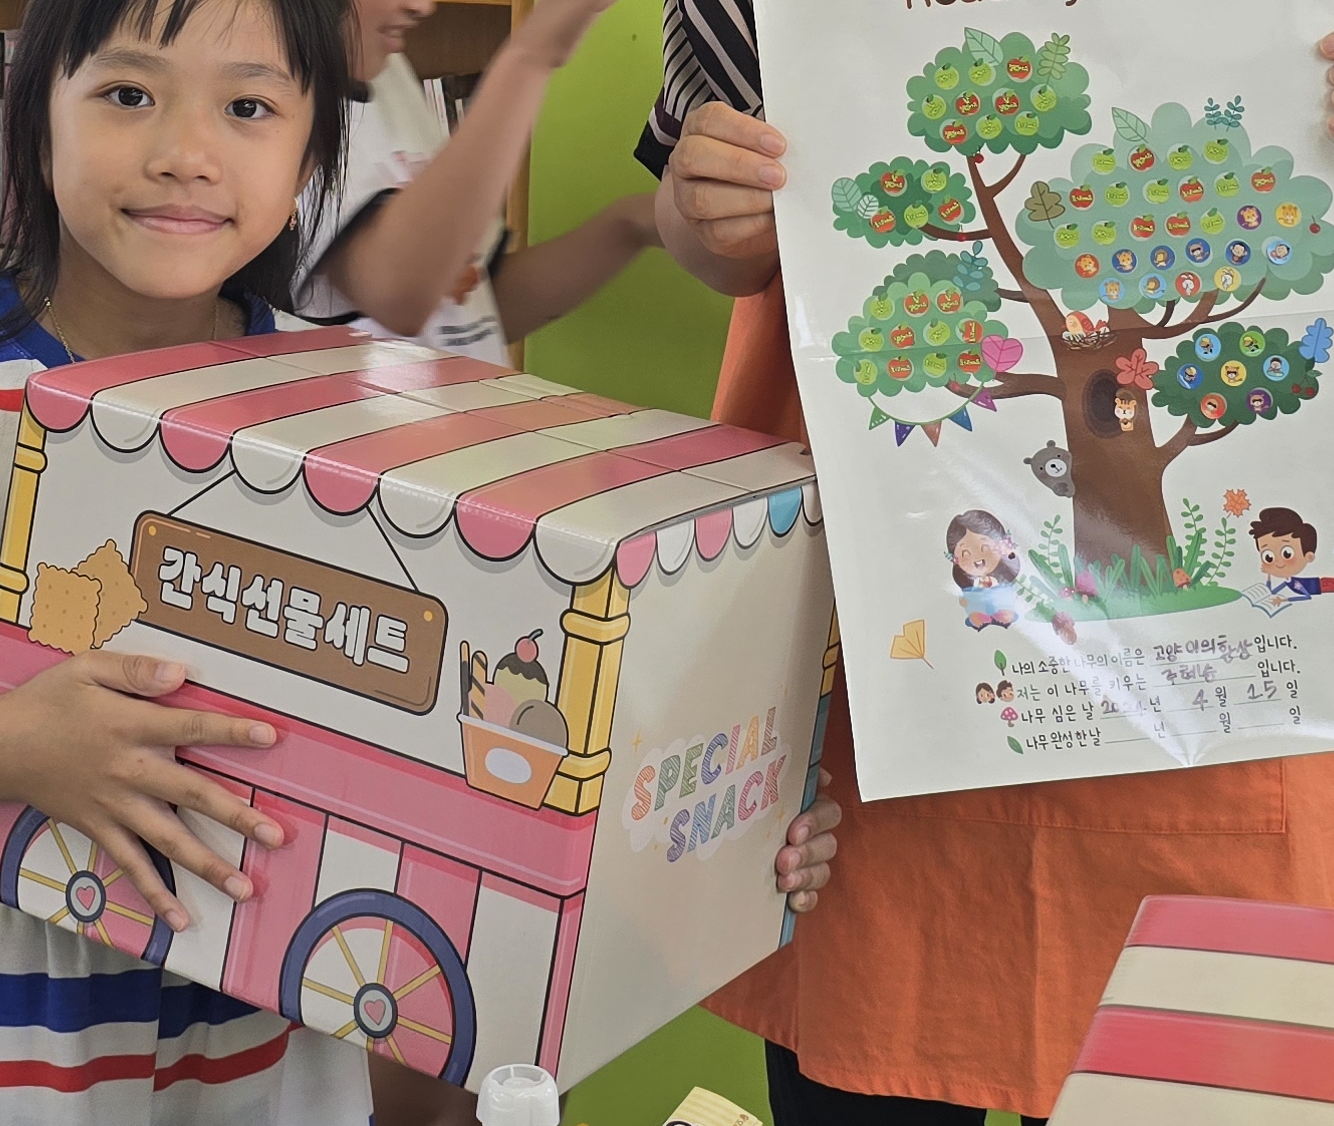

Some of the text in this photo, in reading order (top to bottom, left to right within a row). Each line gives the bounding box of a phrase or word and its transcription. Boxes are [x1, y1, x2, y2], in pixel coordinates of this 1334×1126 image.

[158, 546, 410, 674] 간식선물세트
[1012, 661, 1035, 675] 나의
[1038, 656, 1070, 675] 소중한
[1111, 648, 1145, 667] 이름은
[1254, 634, 1297, 653] 입니다.
[1017, 684, 1041, 701] 저는
[1047, 684, 1058, 697] 이
[1064, 676, 1102, 696] 나무를
[1109, 673, 1146, 691] 키우는
[1257, 658, 1300, 678] 입니다.
[1021, 708, 1046, 723] 나무
[1052, 705, 1076, 723] 심은
[1082, 701, 1094, 720] 날
[1215, 686, 1227, 707] 월
[1286, 680, 1298, 699] 일
[1219, 712, 1231, 733] 월
[1289, 705, 1301, 725] 일
[631, 706, 778, 820] SPECIAL
[667, 754, 787, 862] SNACK
